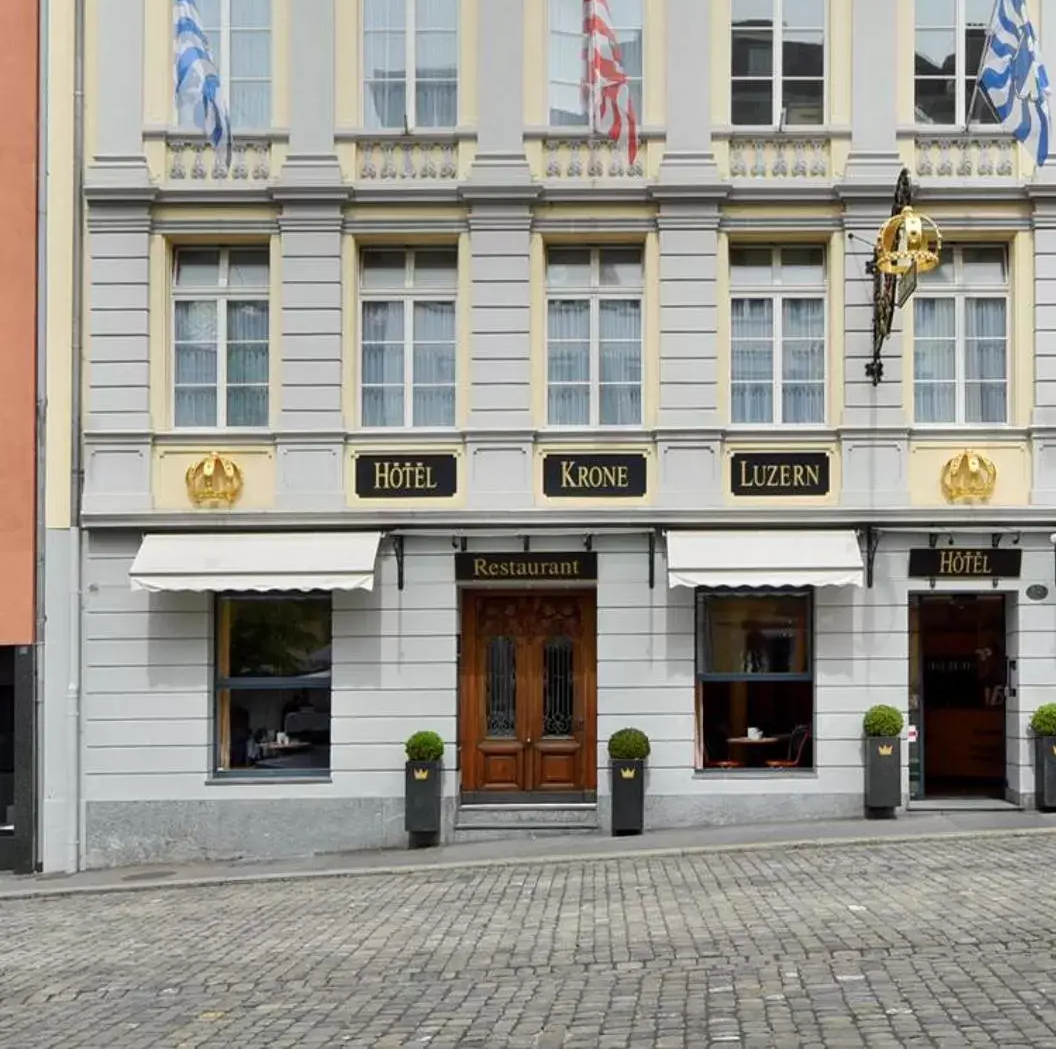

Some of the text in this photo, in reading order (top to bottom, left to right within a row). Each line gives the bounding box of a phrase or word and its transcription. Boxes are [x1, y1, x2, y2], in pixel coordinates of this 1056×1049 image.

[560, 460, 630, 488] KRONE
[740, 460, 820, 487] LUZERN
[473, 557, 580, 576] Restaurant
